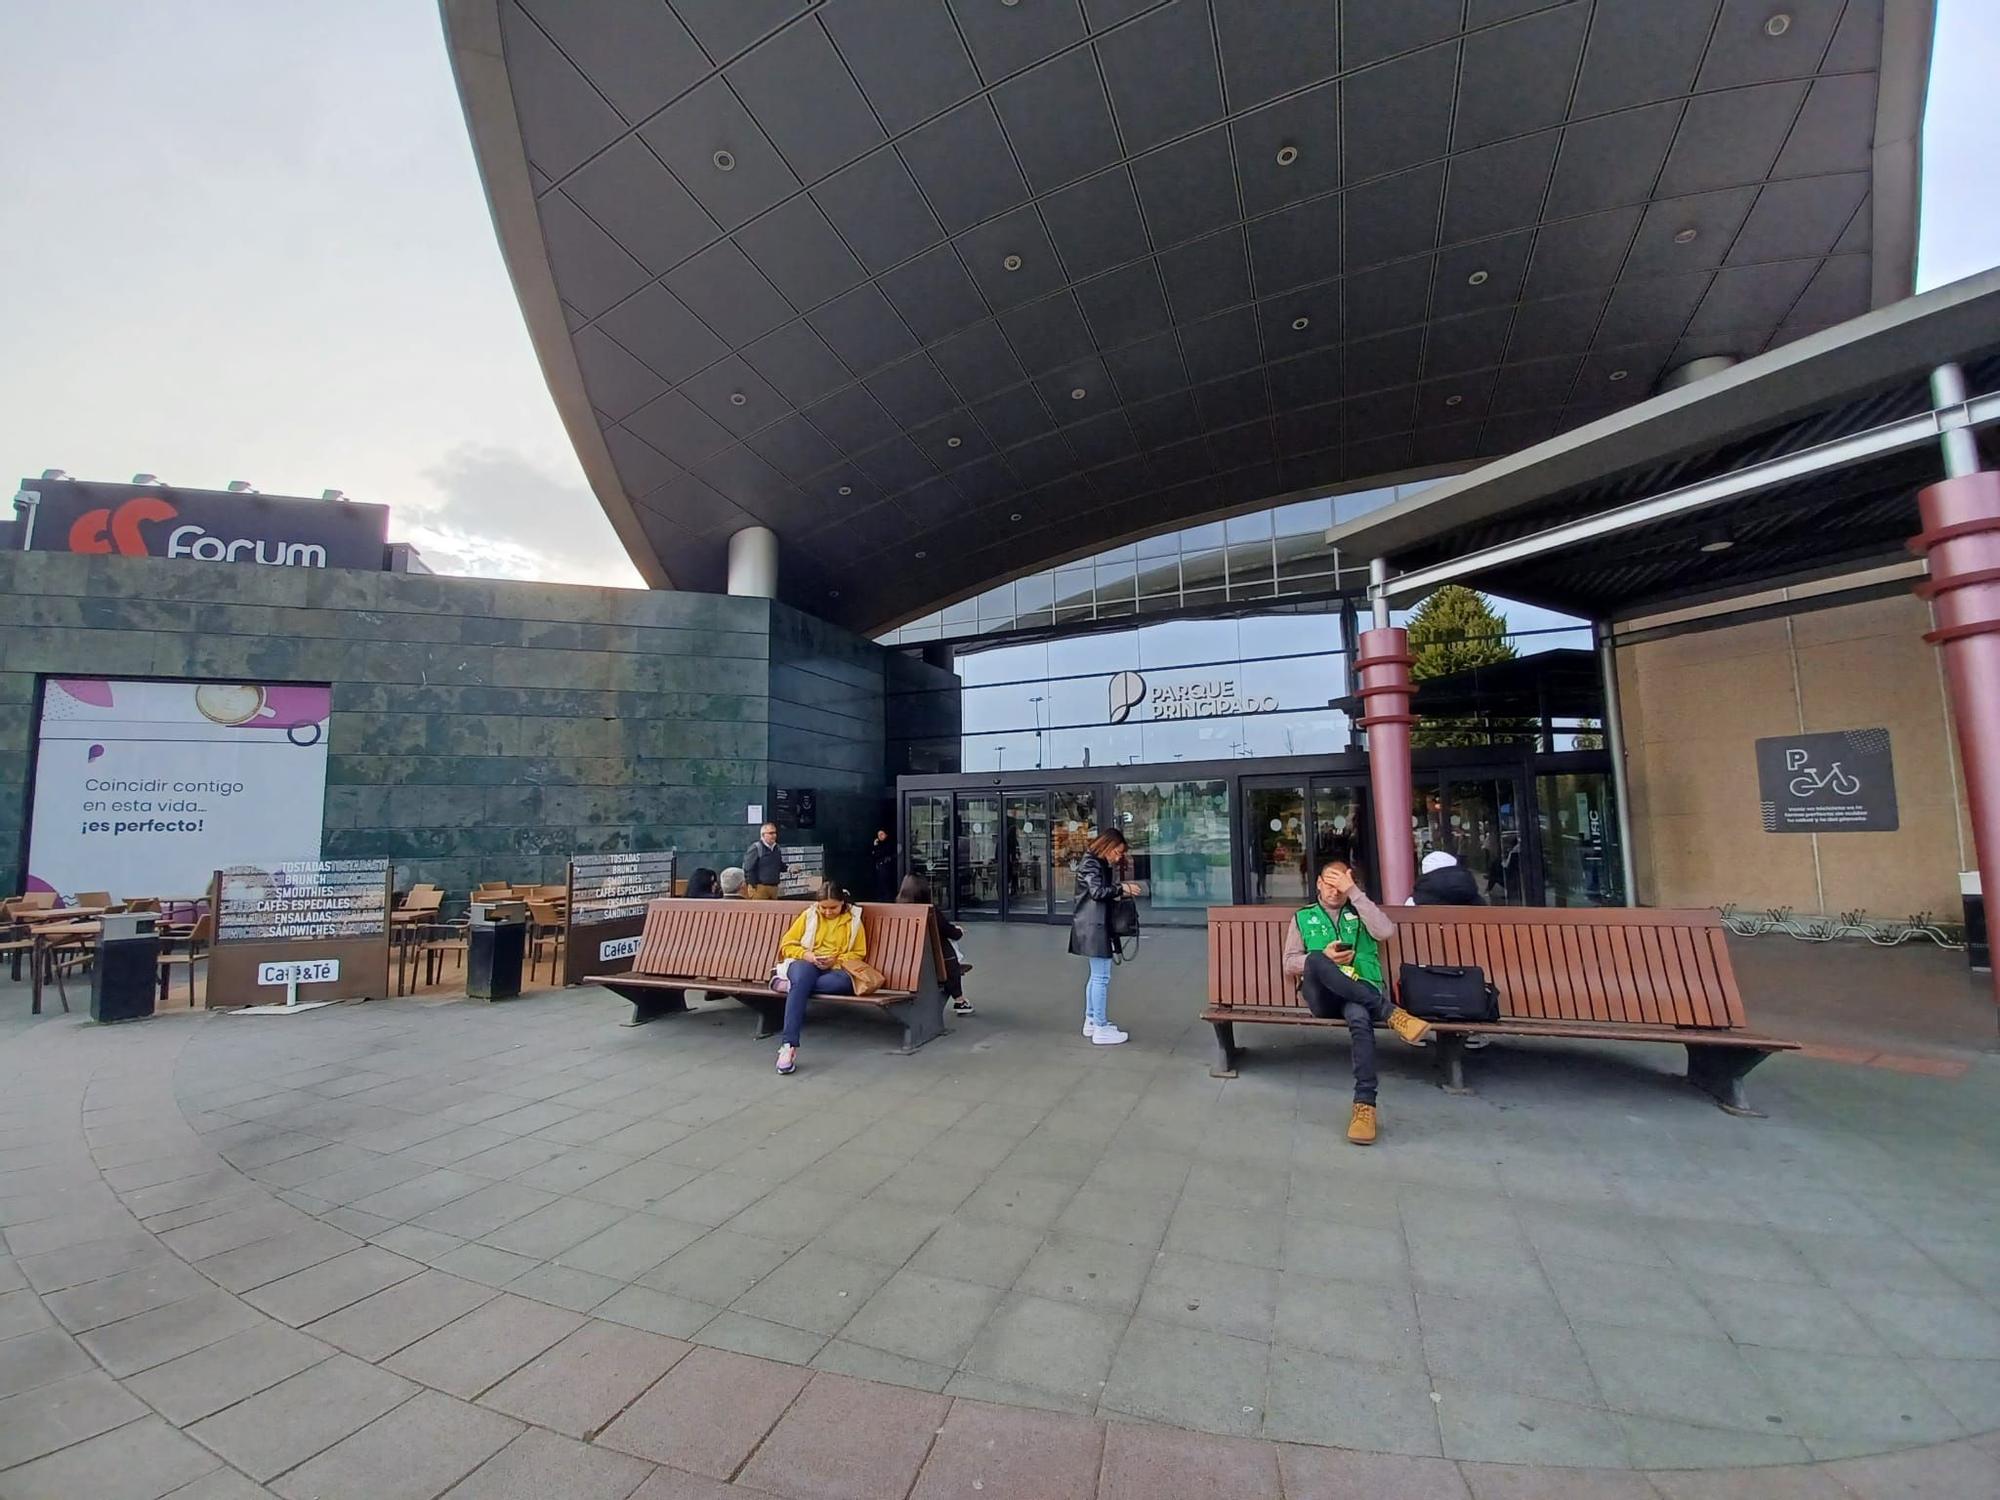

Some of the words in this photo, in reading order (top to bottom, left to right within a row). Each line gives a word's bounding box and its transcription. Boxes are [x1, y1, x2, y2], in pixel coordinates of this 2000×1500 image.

[1152, 680, 1234, 703] PARQUE
[1153, 697, 1278, 719] PRINCIPADO
[1786, 749, 1808, 771] P
[85, 778, 168, 792] Coincidir
[173, 780, 244, 797] contigo
[83, 801, 106, 812] en
[111, 800, 152, 812] esta
[82, 821, 110, 834] ¡es
[114, 819, 204, 836] perfecto!
[281, 861, 331, 872] TOSTADAS
[285, 873, 327, 885] BRUNCH
[276, 886, 334, 898] SMOOTHIES
[291, 898, 350, 910] ESPECIALES
[275, 911, 332, 923] ENSALADAS
[604, 940, 641, 958] Café&T
